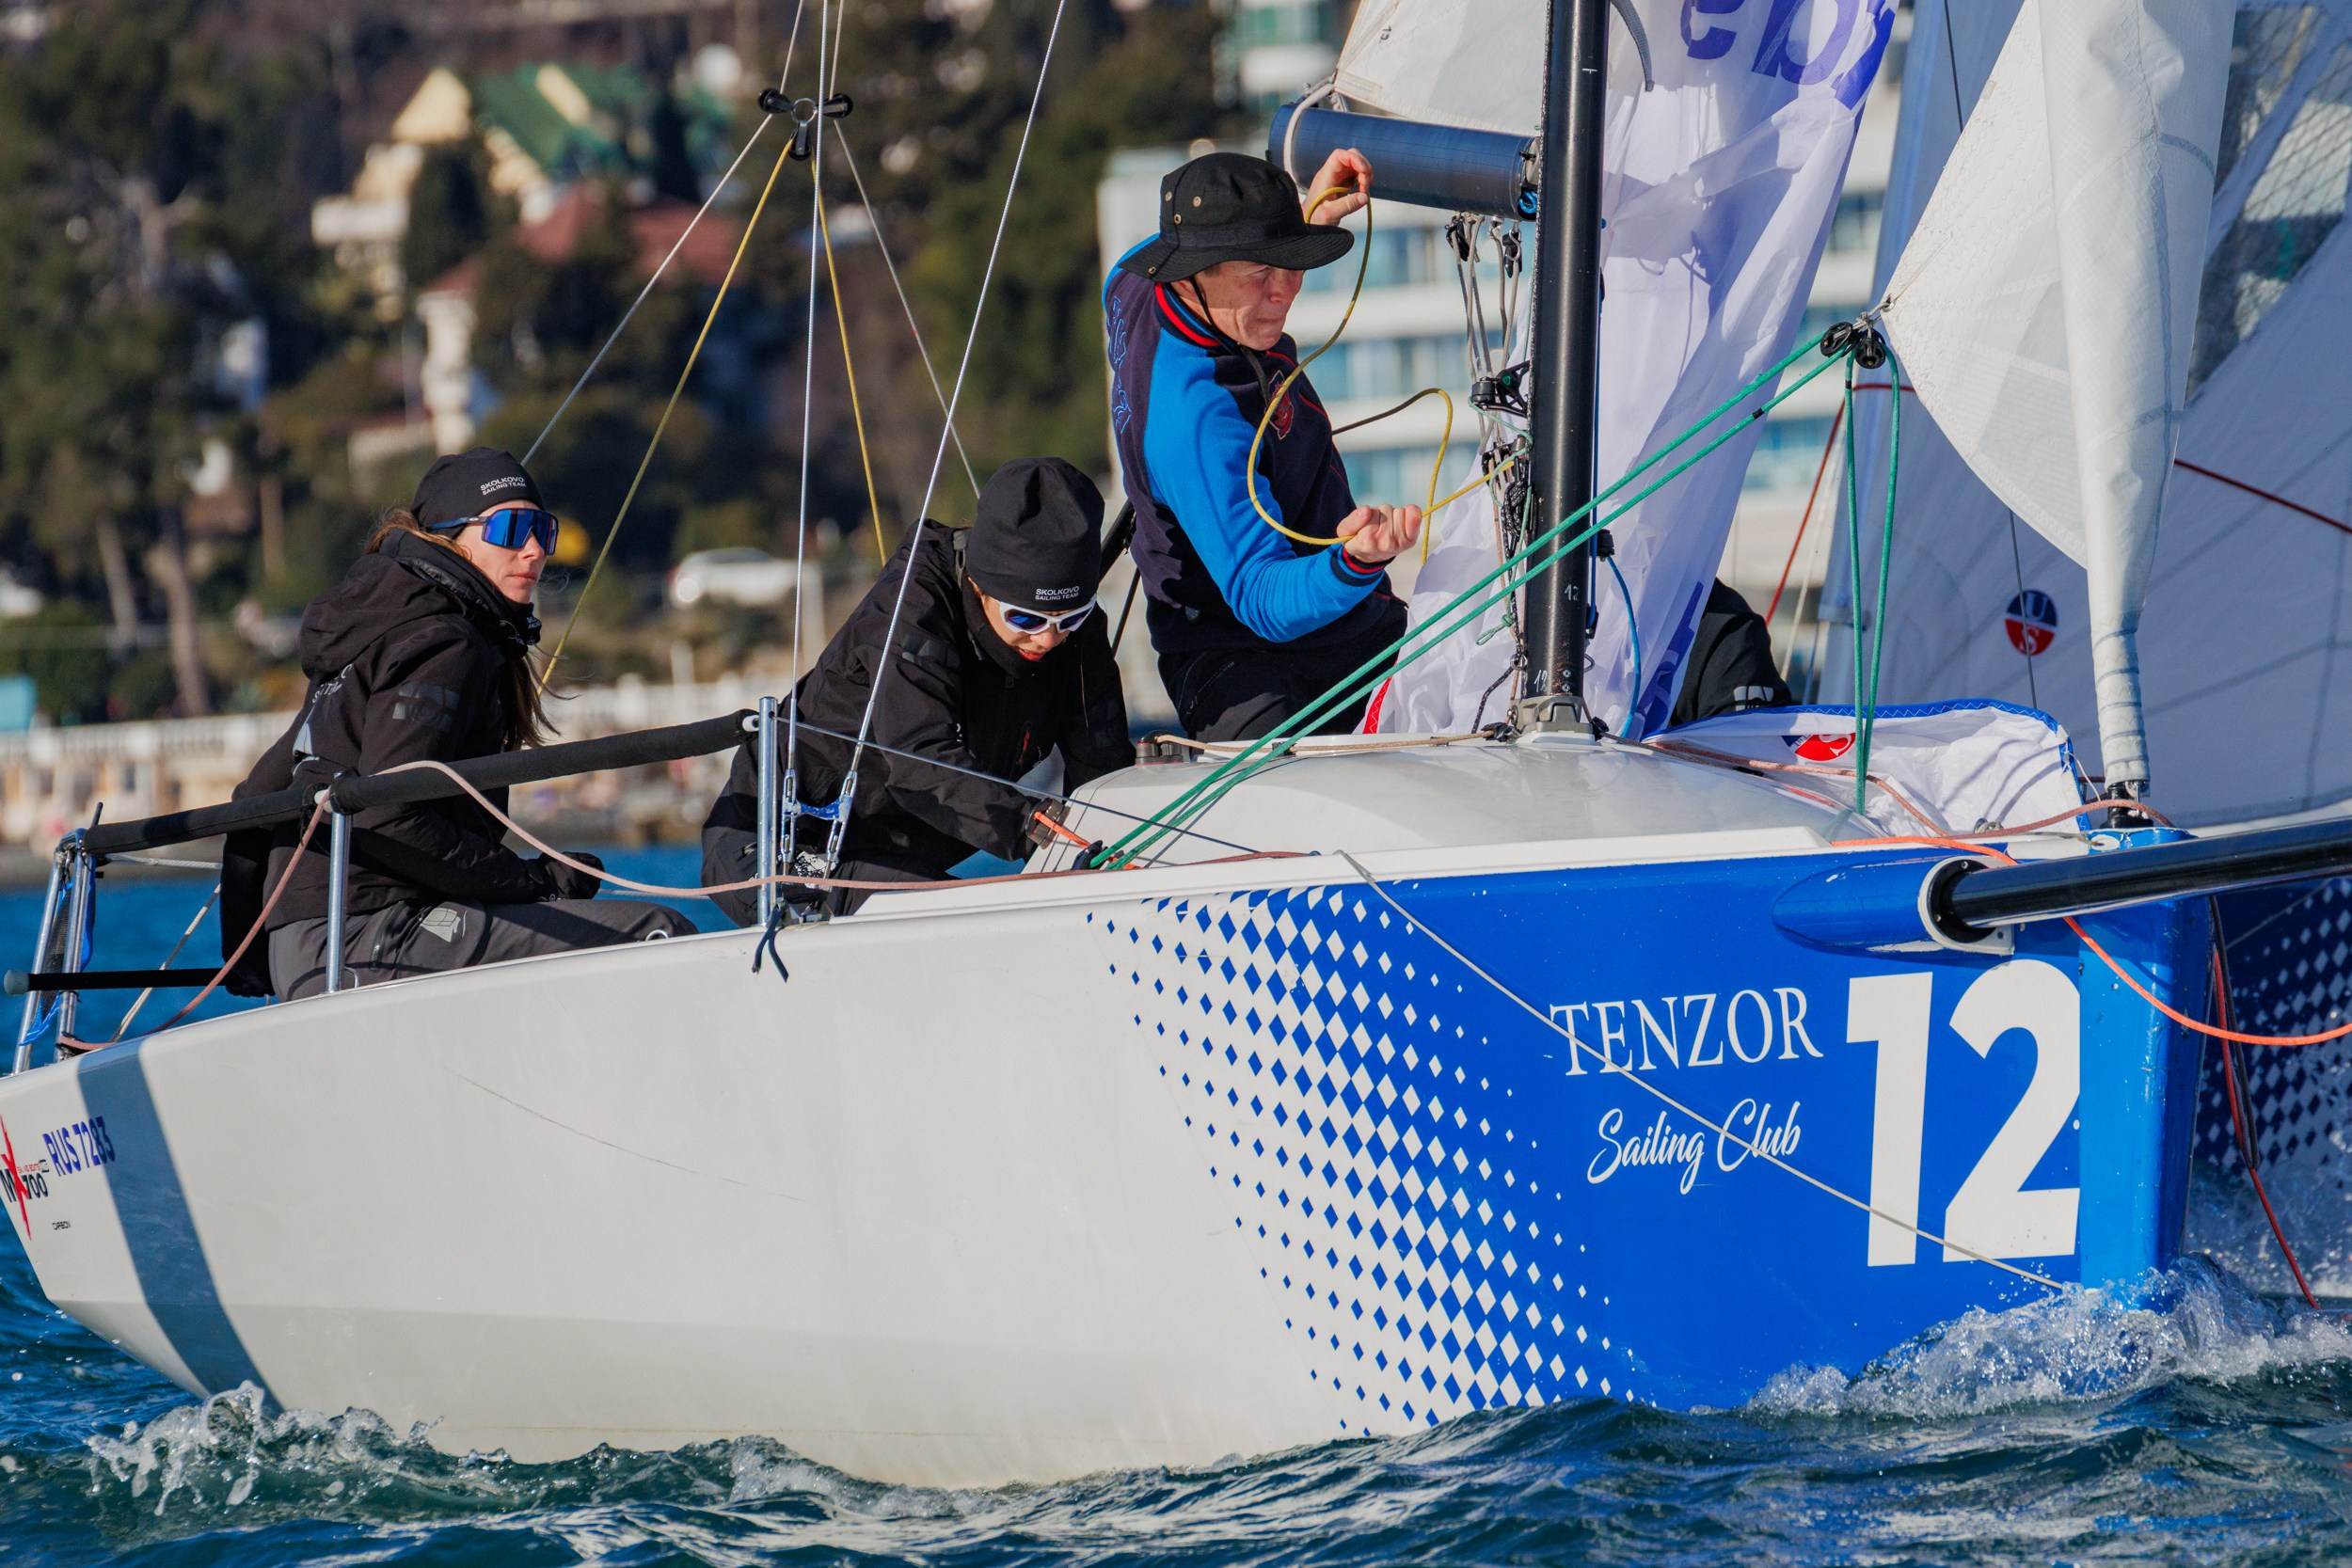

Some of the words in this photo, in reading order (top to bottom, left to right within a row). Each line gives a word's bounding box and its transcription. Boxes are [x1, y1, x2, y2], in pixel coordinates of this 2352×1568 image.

[481, 476, 524, 491] SKOLKOVO
[482, 483, 508, 496] SAILING
[1036, 586, 1080, 596] SKOLKOVO
[1549, 987, 1824, 1076] TENZOR
[1846, 958, 2081, 1267] 12
[42, 1127, 82, 1177] RUS
[72, 1116, 116, 1168] 7283
[1587, 1107, 1706, 1195] Sailing
[1716, 1098, 1802, 1172] Club
